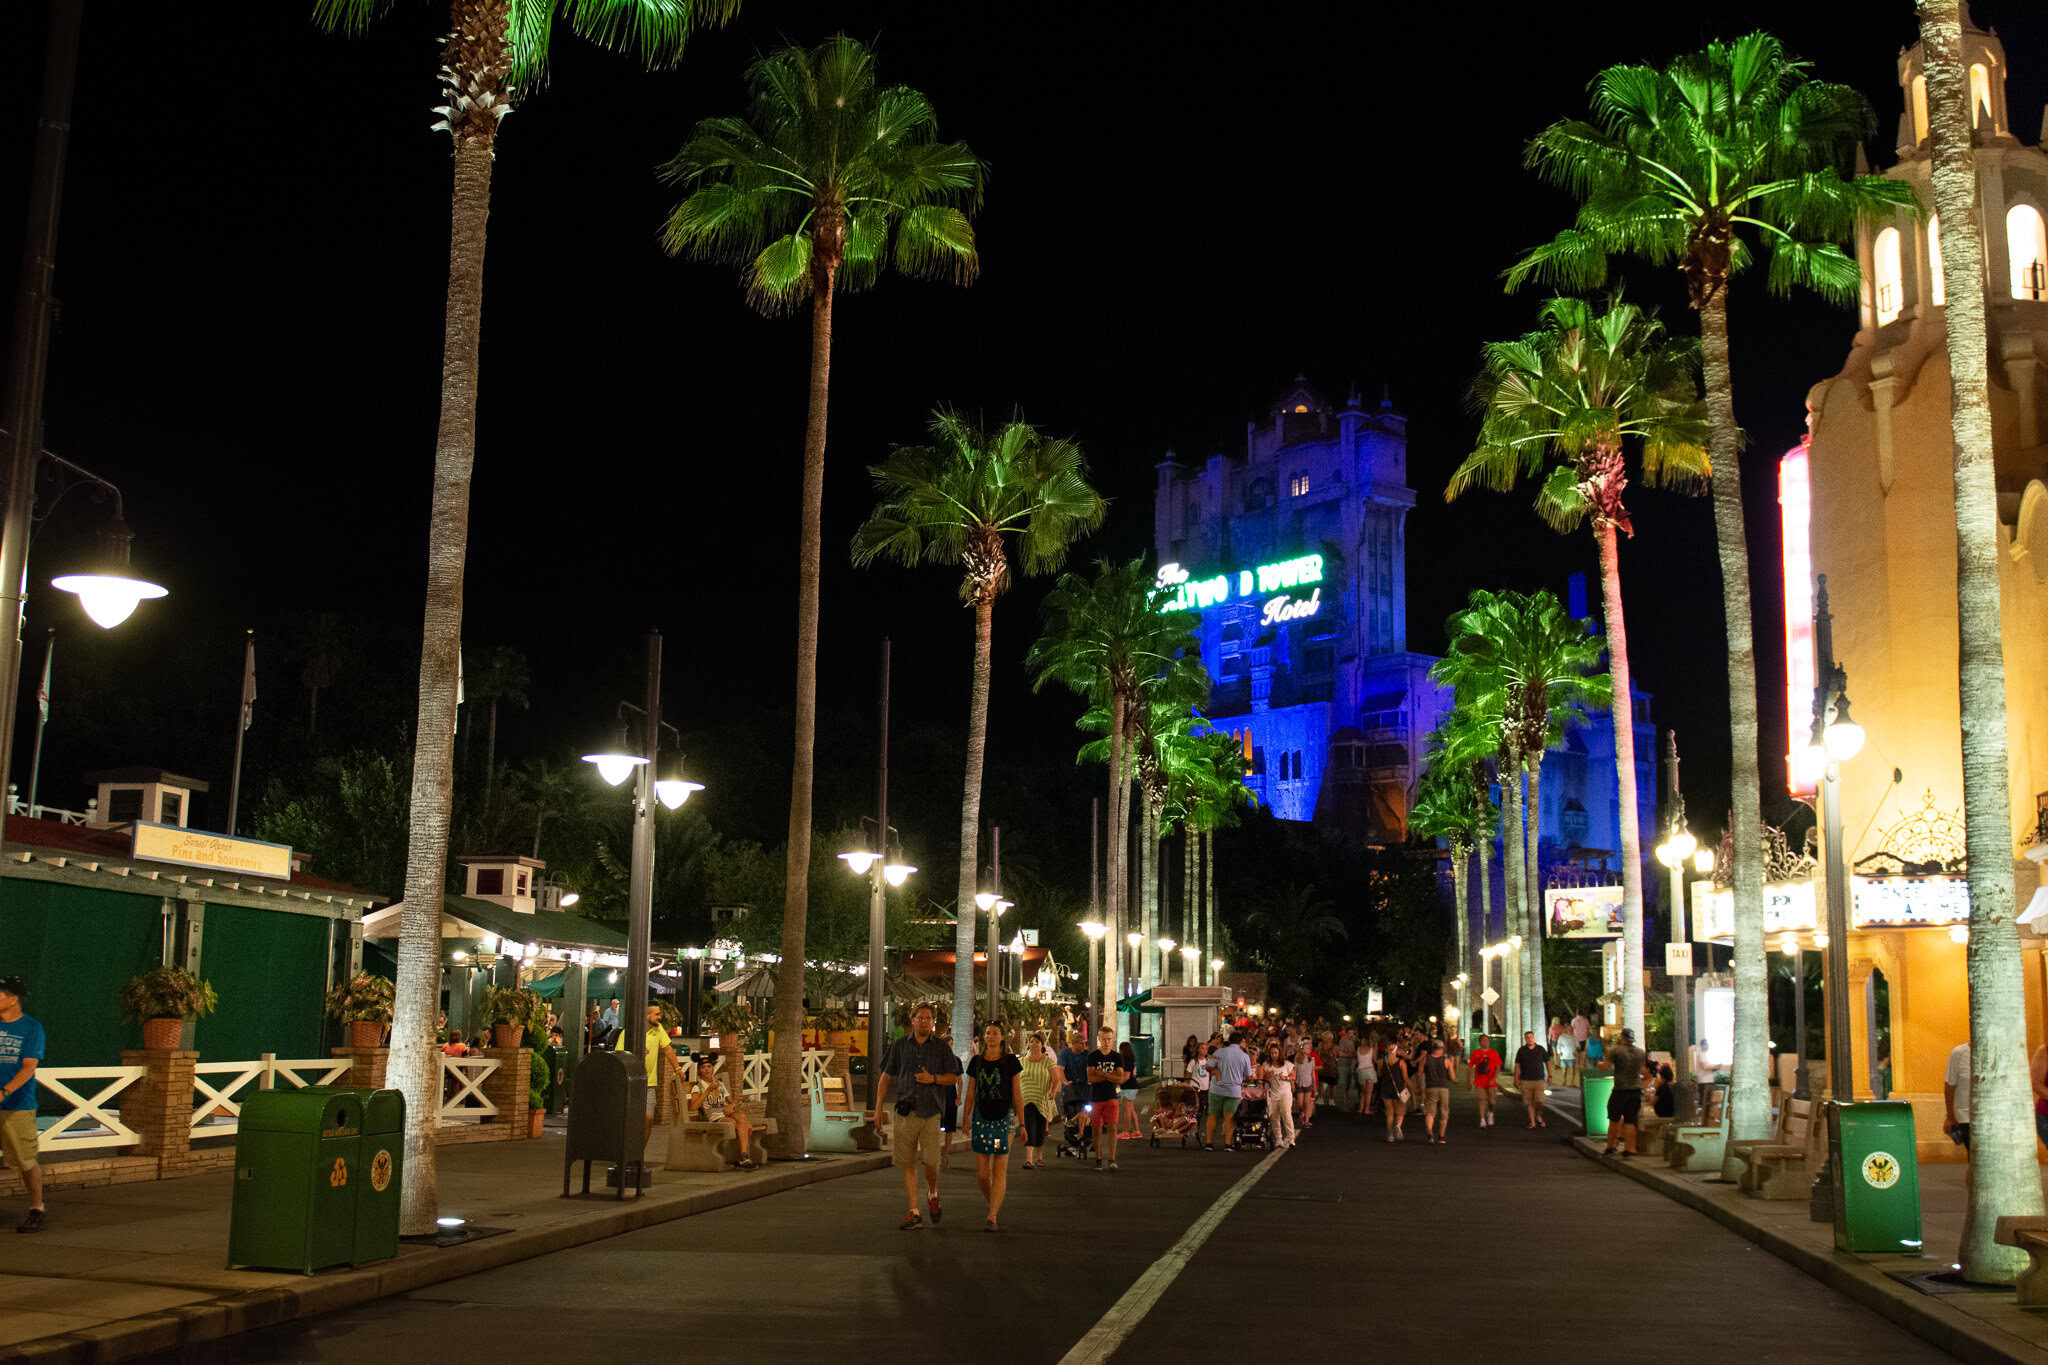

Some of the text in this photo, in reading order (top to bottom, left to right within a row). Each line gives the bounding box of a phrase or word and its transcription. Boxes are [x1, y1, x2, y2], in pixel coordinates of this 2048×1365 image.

[1156, 563, 1189, 588] The
[1257, 554, 1324, 593] TOWER
[1260, 587, 1321, 626] Hotel
[172, 844, 262, 870] Pins and Souvenirs
[1936, 885, 1968, 898] UPO
[1904, 903, 1913, 914] A
[1672, 949, 1689, 959] TAXI
